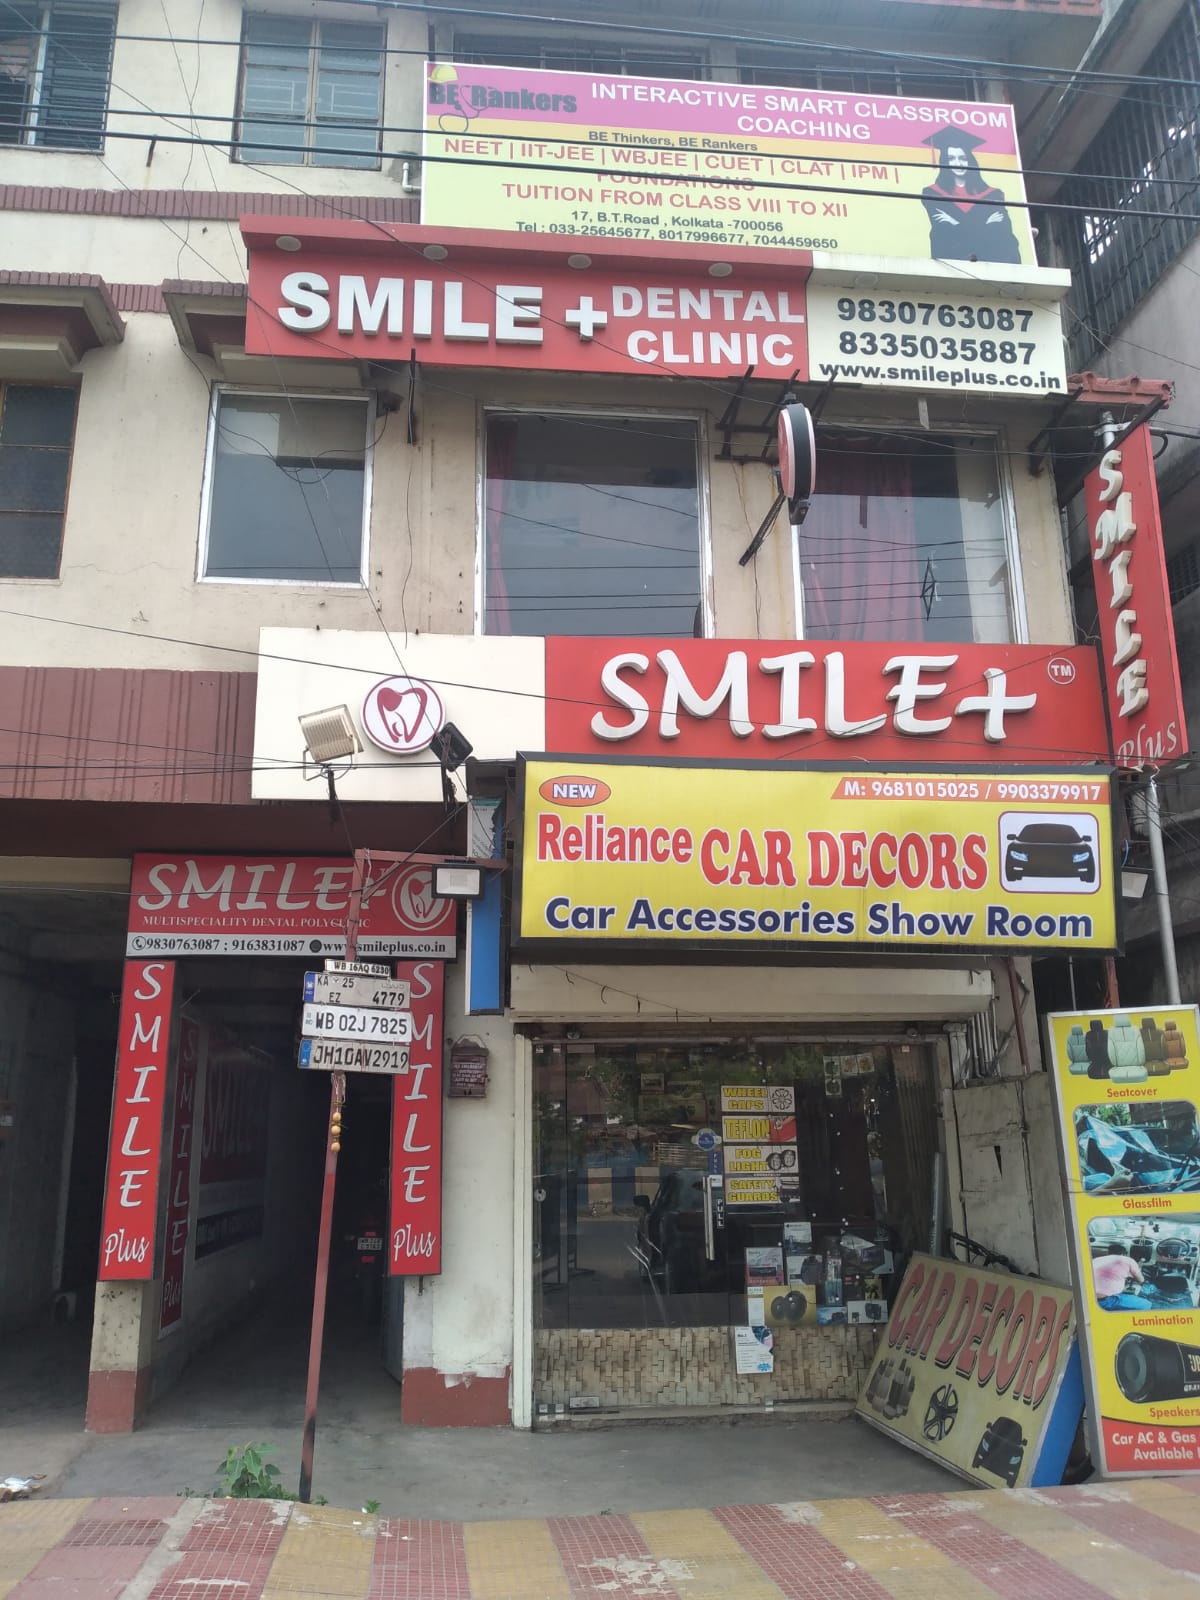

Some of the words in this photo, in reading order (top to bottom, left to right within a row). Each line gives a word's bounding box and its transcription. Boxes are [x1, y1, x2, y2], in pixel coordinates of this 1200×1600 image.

[429, 82, 459, 106] BE
[471, 85, 577, 113] Rankers
[592, 82, 757, 109] INTERACTIVE
[764, 95, 848, 116] SMART
[854, 102, 1008, 129] CLASSROOM
[737, 115, 871, 140] COACHING
[589, 130, 608, 142] BE
[612, 132, 675, 147] Thinkers,
[679, 136, 698, 148] BE
[702, 138, 758, 151] Rankers
[444, 138, 503, 156] NEET
[521, 143, 595, 161] IIT-JEE
[612, 148, 688, 167] WBJEE
[705, 155, 763, 172] CUET
[781, 160, 834, 177] CLAT
[852, 164, 888, 180] IPM
[502, 183, 593, 202] TUITION
[601, 189, 662, 207] FROM
[669, 192, 741, 211] CLASS
[748, 198, 781, 214] VIII
[787, 200, 817, 215] TO
[822, 202, 848, 218] XII
[572, 210, 593, 223] 17,
[597, 212, 659, 226] B.T.Road
[672, 215, 724, 230] Kolkata
[727, 219, 783, 233] -700056
[516, 221, 537, 233] Tel
[549, 223, 655, 240] 033-25645677,
[658, 229, 749, 246] 8017996677,
[753, 234, 838, 249] 7044459650
[277, 271, 544, 345] SMILE
[612, 285, 804, 323] DENTAL
[837, 297, 1034, 333] 9830763087
[627, 329, 793, 366] CLINIC
[839, 331, 1036, 366] 8335035887
[819, 362, 1061, 390] www.smileplus.co.in
[1094, 449, 1150, 718] SMILE
[590, 649, 1038, 743] SMILE+
[1051, 664, 1072, 677] TM
[552, 783, 598, 799] NEW
[843, 780, 866, 797] M:
[872, 781, 979, 799] 9681015025
[997, 784, 1101, 801] 9903379917
[537, 812, 693, 863] Reliance
[700, 827, 798, 888] CAR
[807, 831, 988, 891] DECORS
[143, 915, 249, 928] MULTISPECIALITY
[252, 917, 298, 928] DENTAL
[545, 896, 616, 930] Car
[626, 898, 855, 934] Accessories
[867, 902, 976, 937] Show
[986, 905, 1093, 938] Room
[146, 938, 220, 950] 9830763087
[232, 938, 305, 951] 9163831087
[317, 976, 329, 986] KA
[342, 978, 354, 988] 25
[329, 992, 341, 1003] EZ
[373, 991, 405, 1006] 4779
[316, 1011, 335, 1030] WB
[339, 1014, 366, 1033] 02J
[370, 1017, 408, 1035] 7825
[119, 963, 166, 1208] SMILE
[403, 962, 435, 1203] SMILE
[1107, 1088, 1158, 1098] Seatcover
[728, 1100, 764, 1110] CAPS
[725, 1118, 770, 1140] TEFLON
[729, 1161, 768, 1171] LIGHT
[735, 1149, 762, 1159] FOG
[728, 1192, 778, 1202] GUARDS
[730, 1179, 774, 1190] SAFETY
[1122, 1197, 1172, 1209] Glassfilm
[104, 1228, 150, 1267] Plus
[394, 1223, 436, 1262] Plus
[888, 1262, 956, 1360] CAR
[1132, 1314, 1194, 1327] Lamination
[1112, 1432, 1133, 1445] Car
[1137, 1431, 1154, 1444] AC
[1171, 1430, 1197, 1443] Gas
[1133, 1448, 1194, 1461] Available
